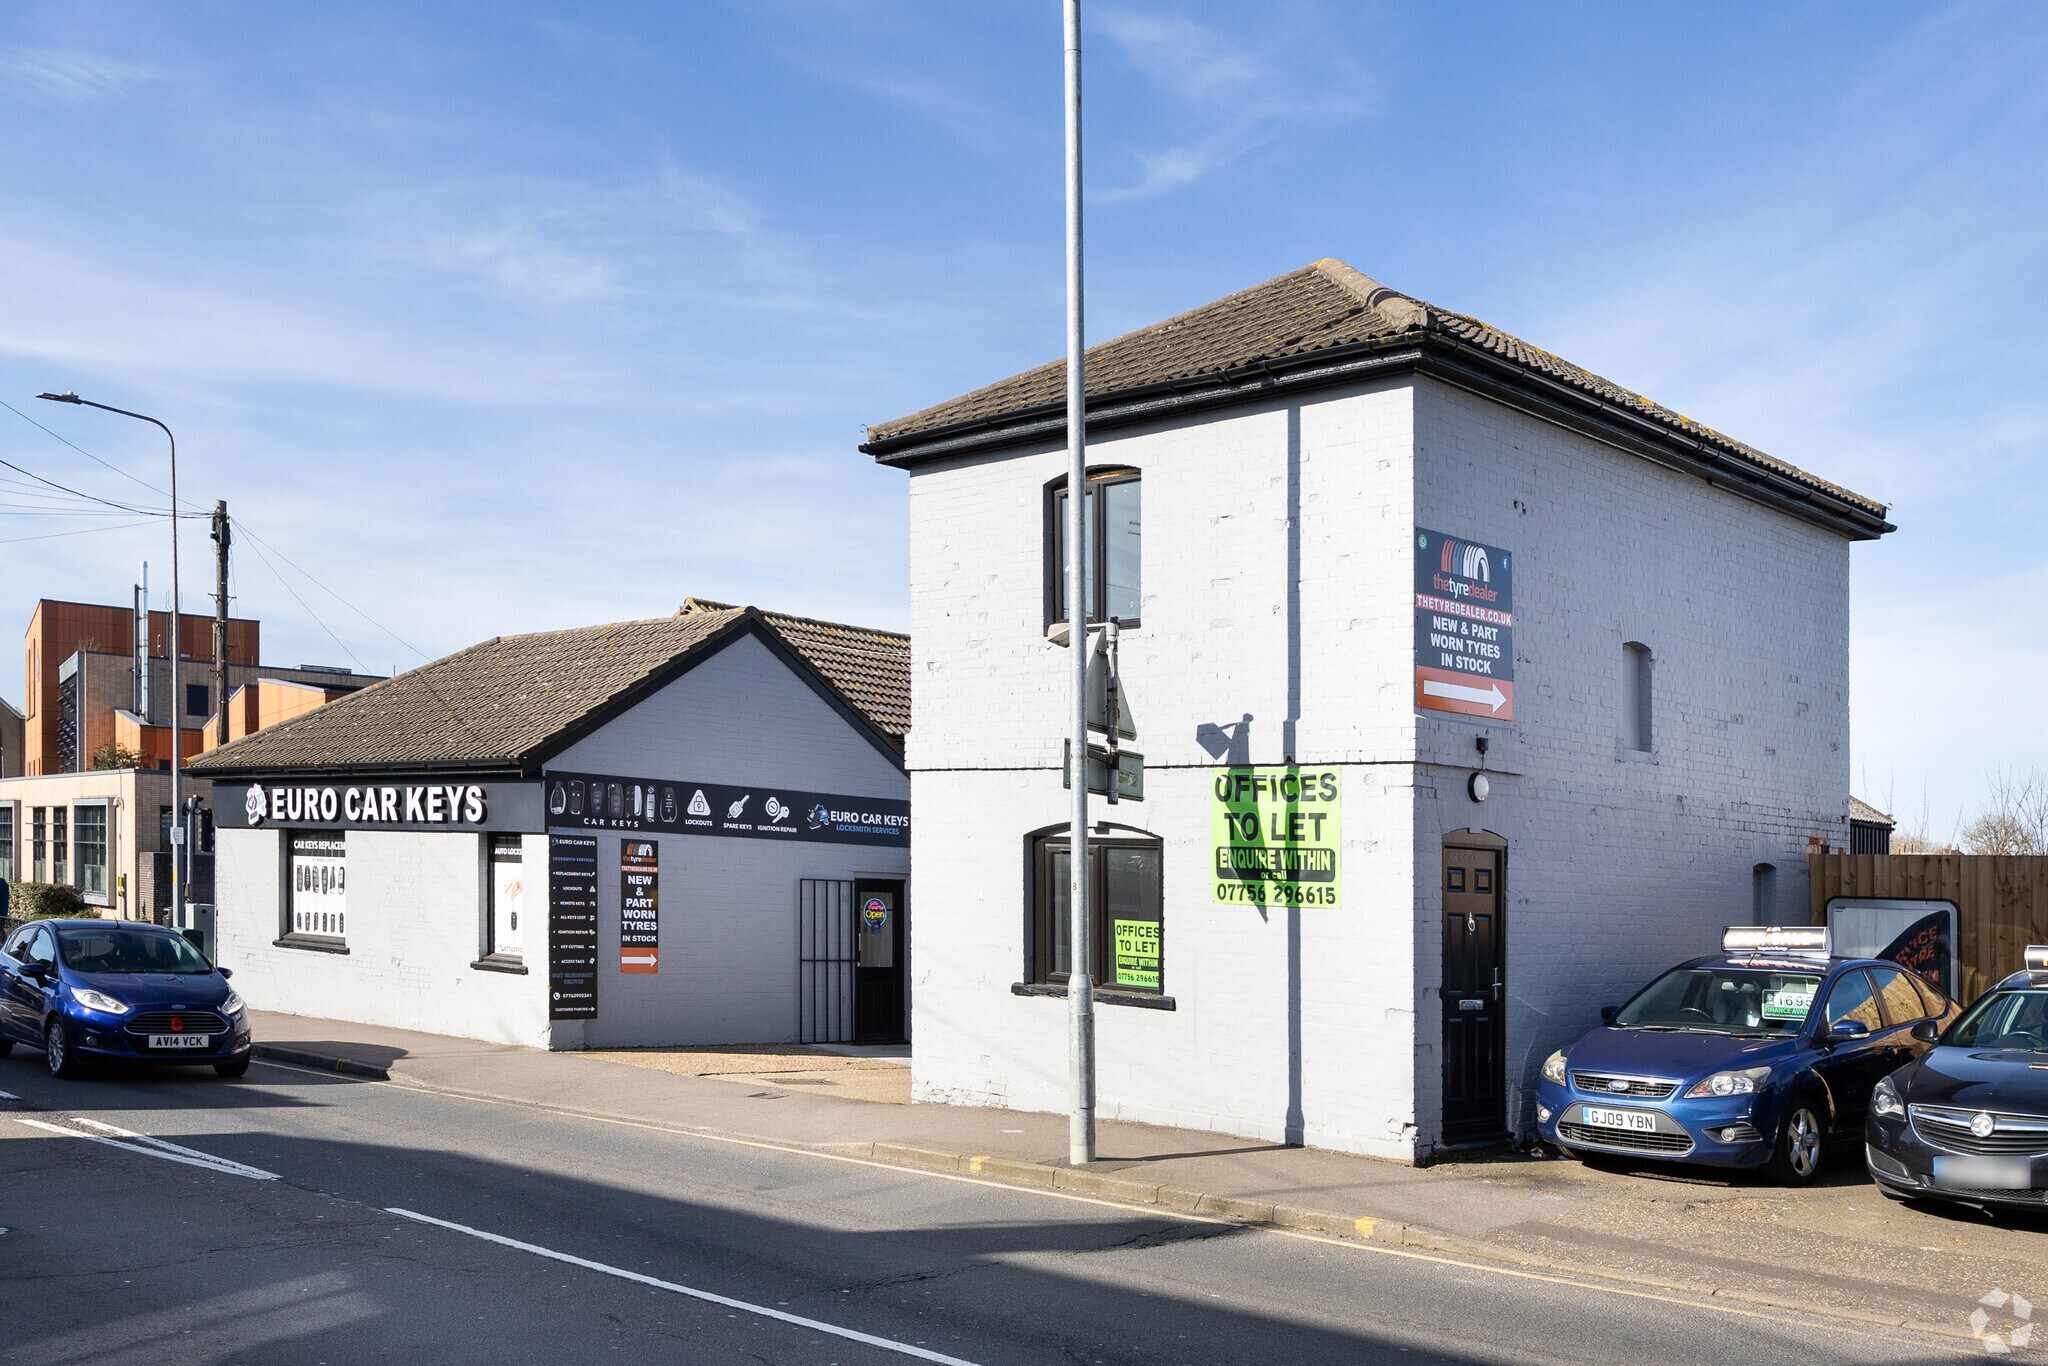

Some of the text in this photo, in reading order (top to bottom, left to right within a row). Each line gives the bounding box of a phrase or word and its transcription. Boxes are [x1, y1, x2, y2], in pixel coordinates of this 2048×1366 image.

[1433, 572, 1498, 602] thetyredealer
[1416, 594, 1512, 626] THETYREDEALER.CO.UK
[1433, 615, 1498, 641] NEW & PART
[1430, 632, 1501, 659] WORN TYRES
[1441, 652, 1492, 674] IN STOCK
[1215, 772, 1338, 803] OFFICES
[272, 785, 484, 822] EURO CAR KEYS
[584, 817, 639, 828] CAR KEYS
[685, 819, 713, 827] LOCKOUTS
[830, 810, 909, 827] EURO CAR KEYS
[723, 822, 739, 830] SPARE
[836, 824, 900, 835] LOCKSMITH SERVICES
[1224, 812, 1328, 842] TO LET
[294, 840, 305, 849] CAR
[305, 840, 319, 850] KEYS
[495, 847, 507, 855] AUTO
[1220, 848, 1331, 871] ENQUIRE WITHIN
[627, 875, 652, 885] NEW
[1260, 870, 1287, 880] or call
[635, 887, 644, 896] &
[1217, 883, 1336, 905] 07756 296615
[626, 898, 653, 908] PART
[623, 910, 656, 919] WORN
[622, 921, 657, 931] TYRES
[1116, 925, 1159, 938] OFFICES
[1119, 939, 1157, 953] TO LET
[1117, 972, 1134, 981] 07756
[1764, 1006, 1791, 1014] FINANCE
[183, 1036, 203, 1046] VCK
[1591, 1110, 1653, 1130] GJ09 YBN
